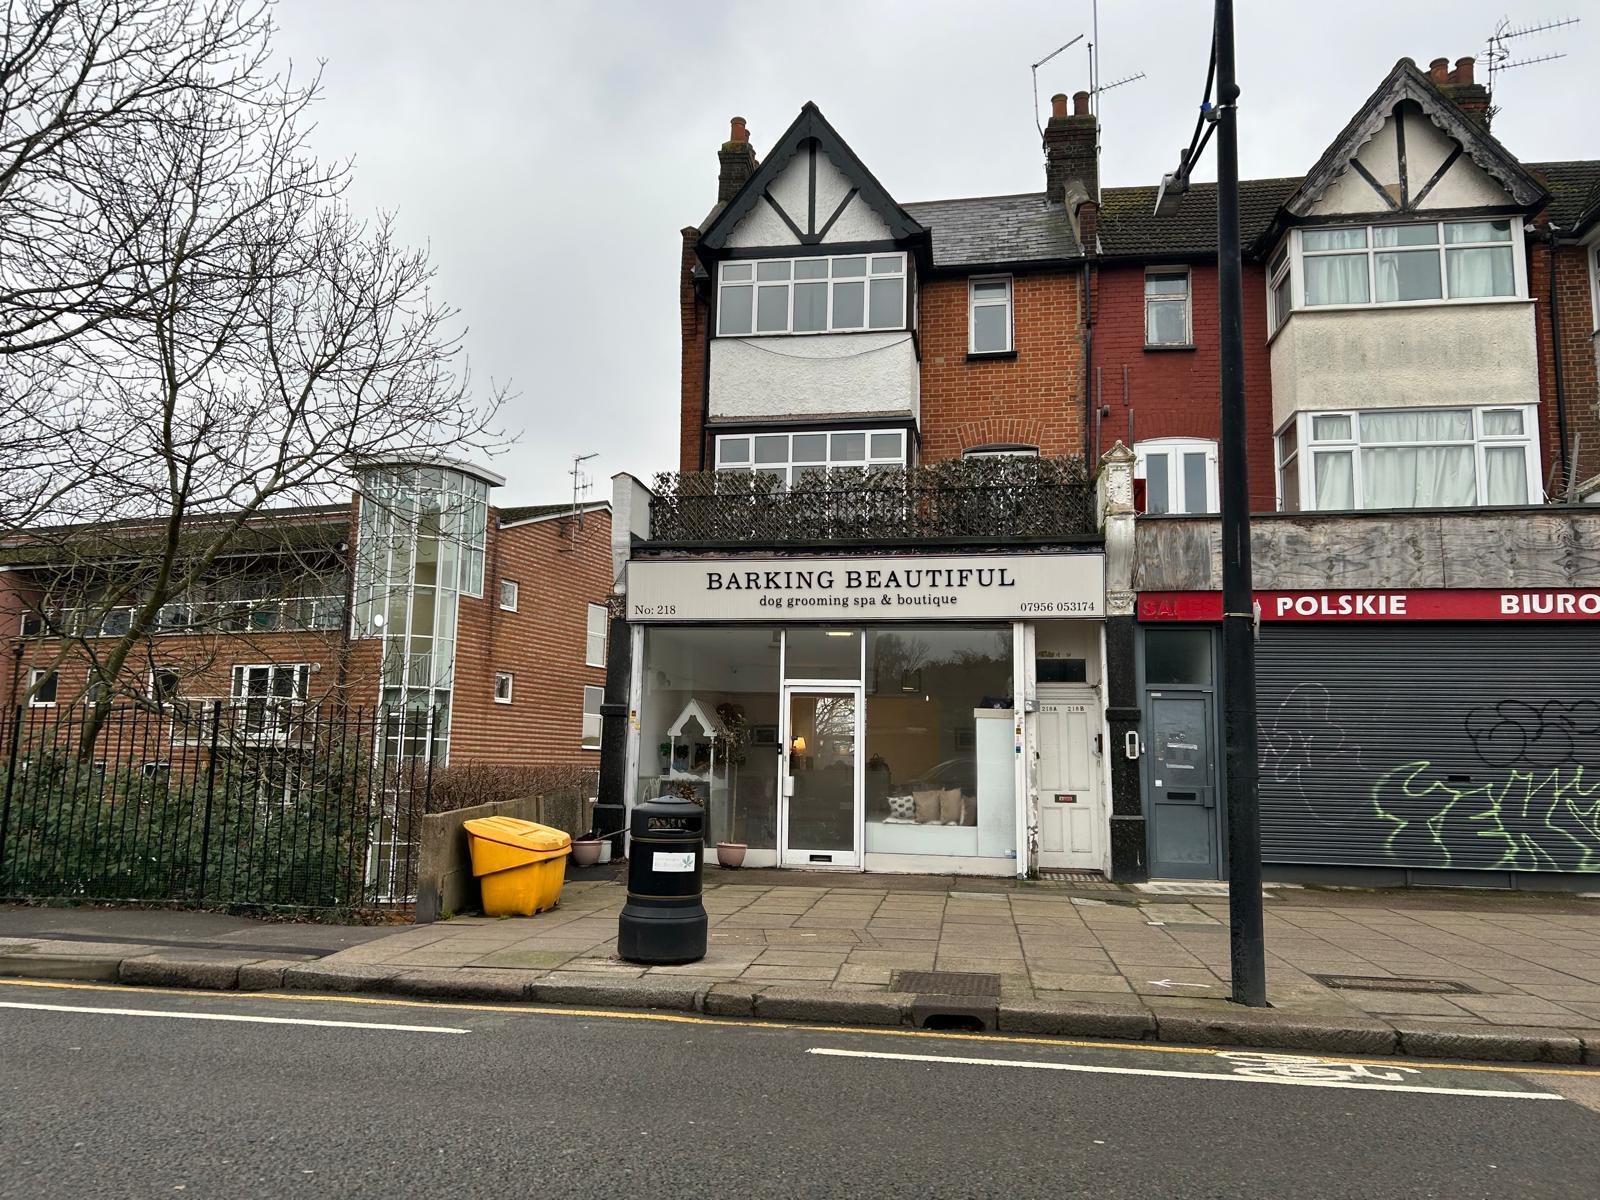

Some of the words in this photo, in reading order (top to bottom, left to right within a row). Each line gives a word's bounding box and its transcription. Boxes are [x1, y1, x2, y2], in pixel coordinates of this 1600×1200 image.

[706, 570, 835, 590] BARKING
[845, 568, 1016, 589] BEAUTIFUL
[759, 594, 783, 608] dog
[786, 594, 849, 609] grooming
[853, 597, 876, 609] spa
[880, 594, 892, 606] &
[897, 593, 957, 608] boutique
[1020, 602, 1054, 613] 07956
[1056, 601, 1095, 612] 053174
[1276, 595, 1407, 617] POLSKIE
[1500, 593, 1600, 614] BIURO
[634, 604, 654, 615] No:
[657, 605, 676, 615] 218
